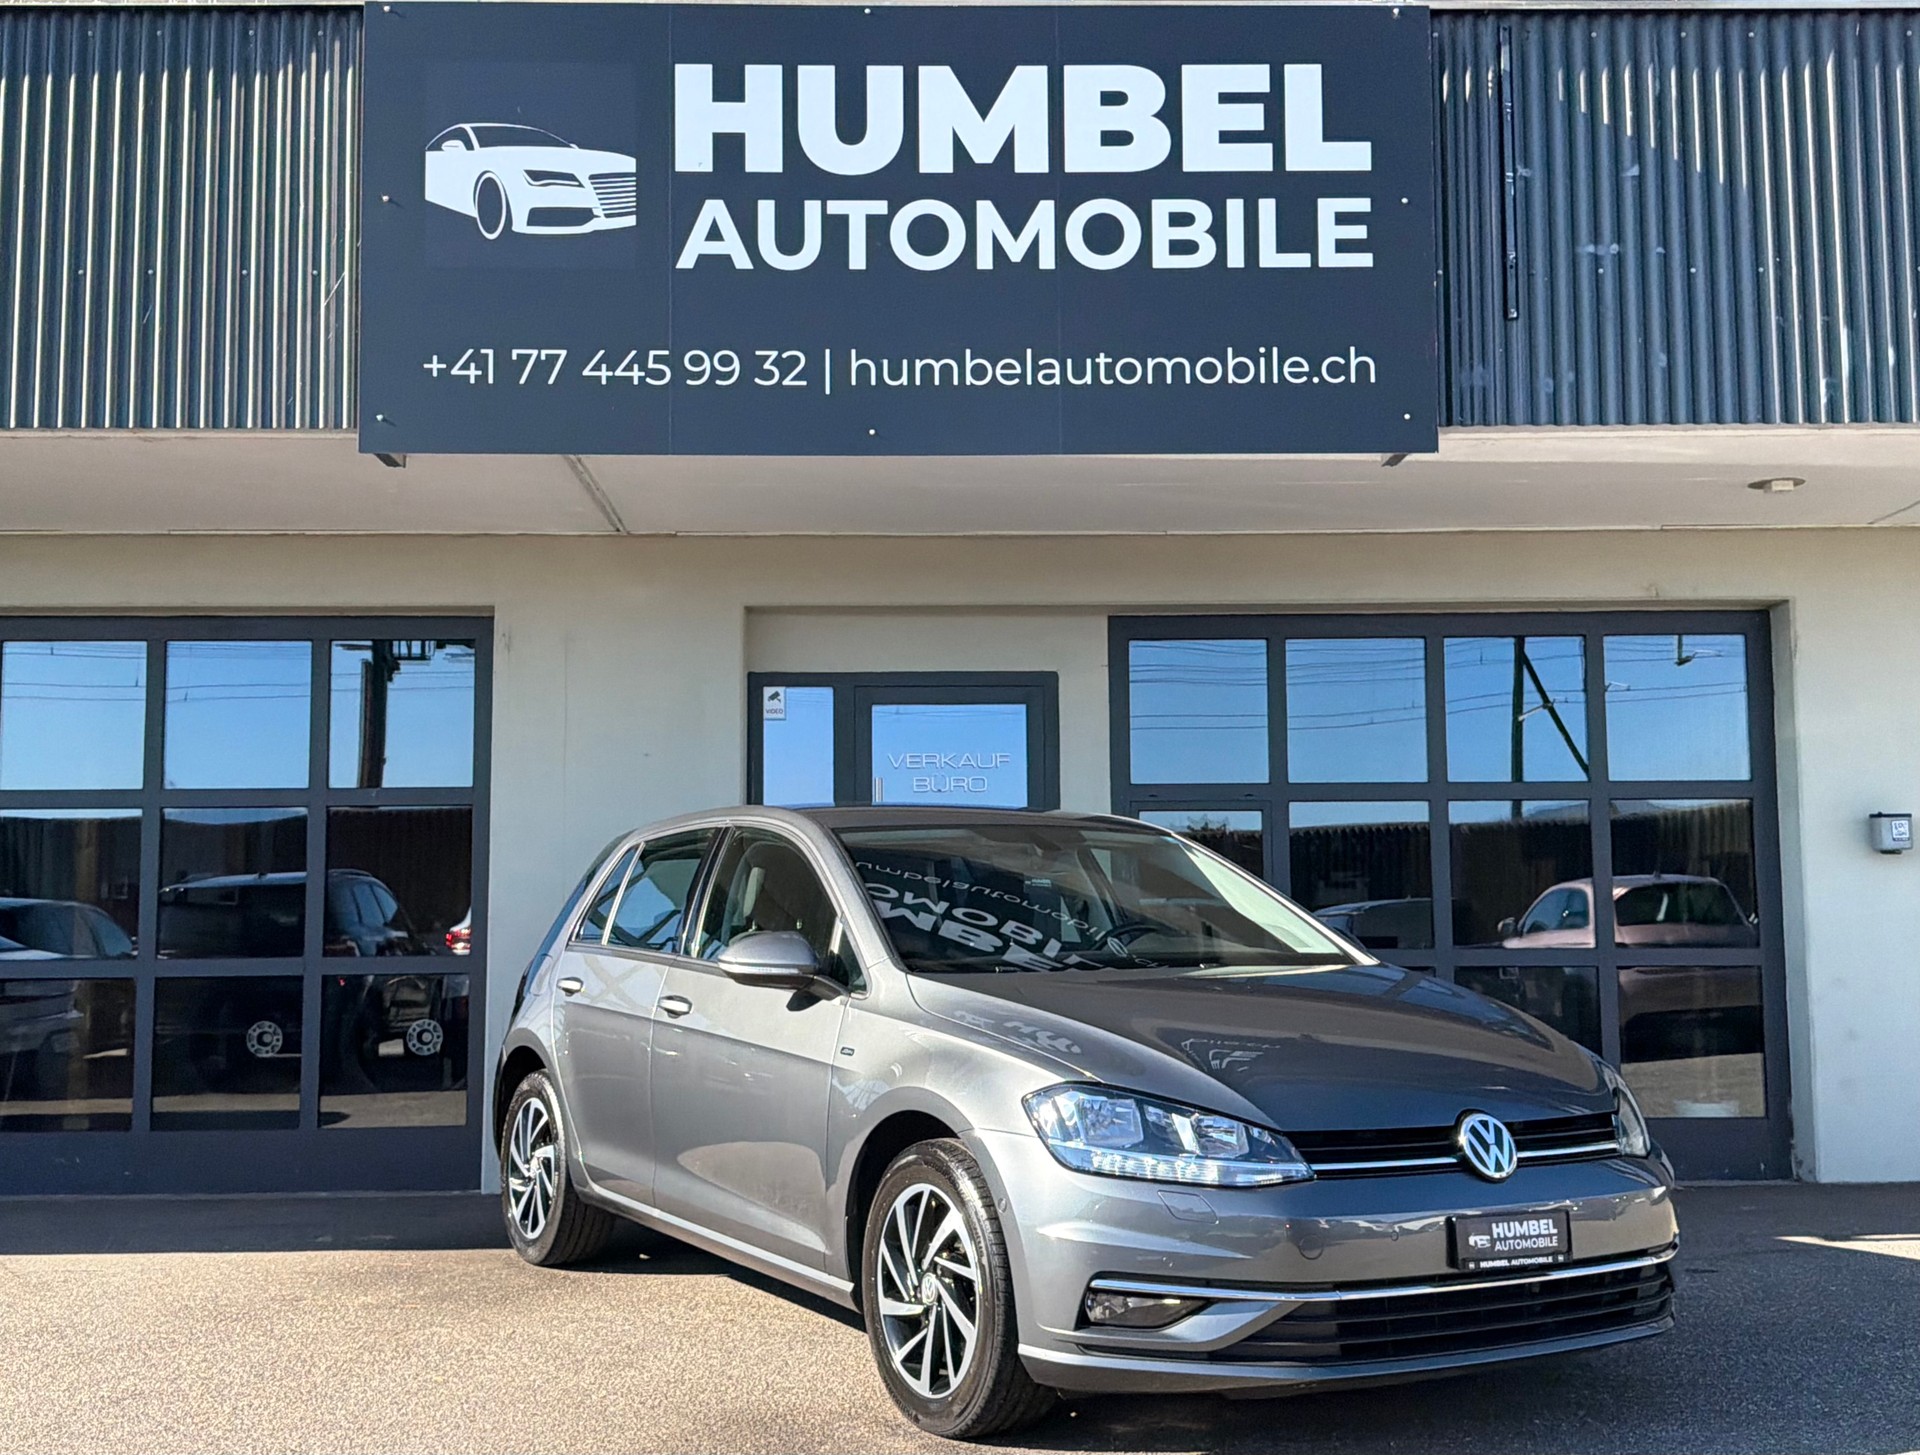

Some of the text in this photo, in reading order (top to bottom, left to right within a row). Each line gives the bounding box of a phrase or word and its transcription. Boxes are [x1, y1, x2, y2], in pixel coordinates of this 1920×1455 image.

[674, 63, 1372, 175] HUMBEL
[676, 197, 1374, 272] AUTOMOBILE
[422, 348, 494, 385] +41
[511, 348, 568, 385] 77
[581, 349, 672, 386] 445
[683, 349, 741, 386] 99
[753, 349, 808, 386] 32
[850, 345, 1376, 386] humbelautomobile.ch
[887, 752, 1011, 769] VERKAUF
[912, 772, 988, 792] BÜRO
[1491, 1219, 1558, 1239] HUMBEL
[1494, 1236, 1558, 1251] AUTOMOBILE
[1480, 1256, 1553, 1268] HUMBEL AUTOMOBILE
